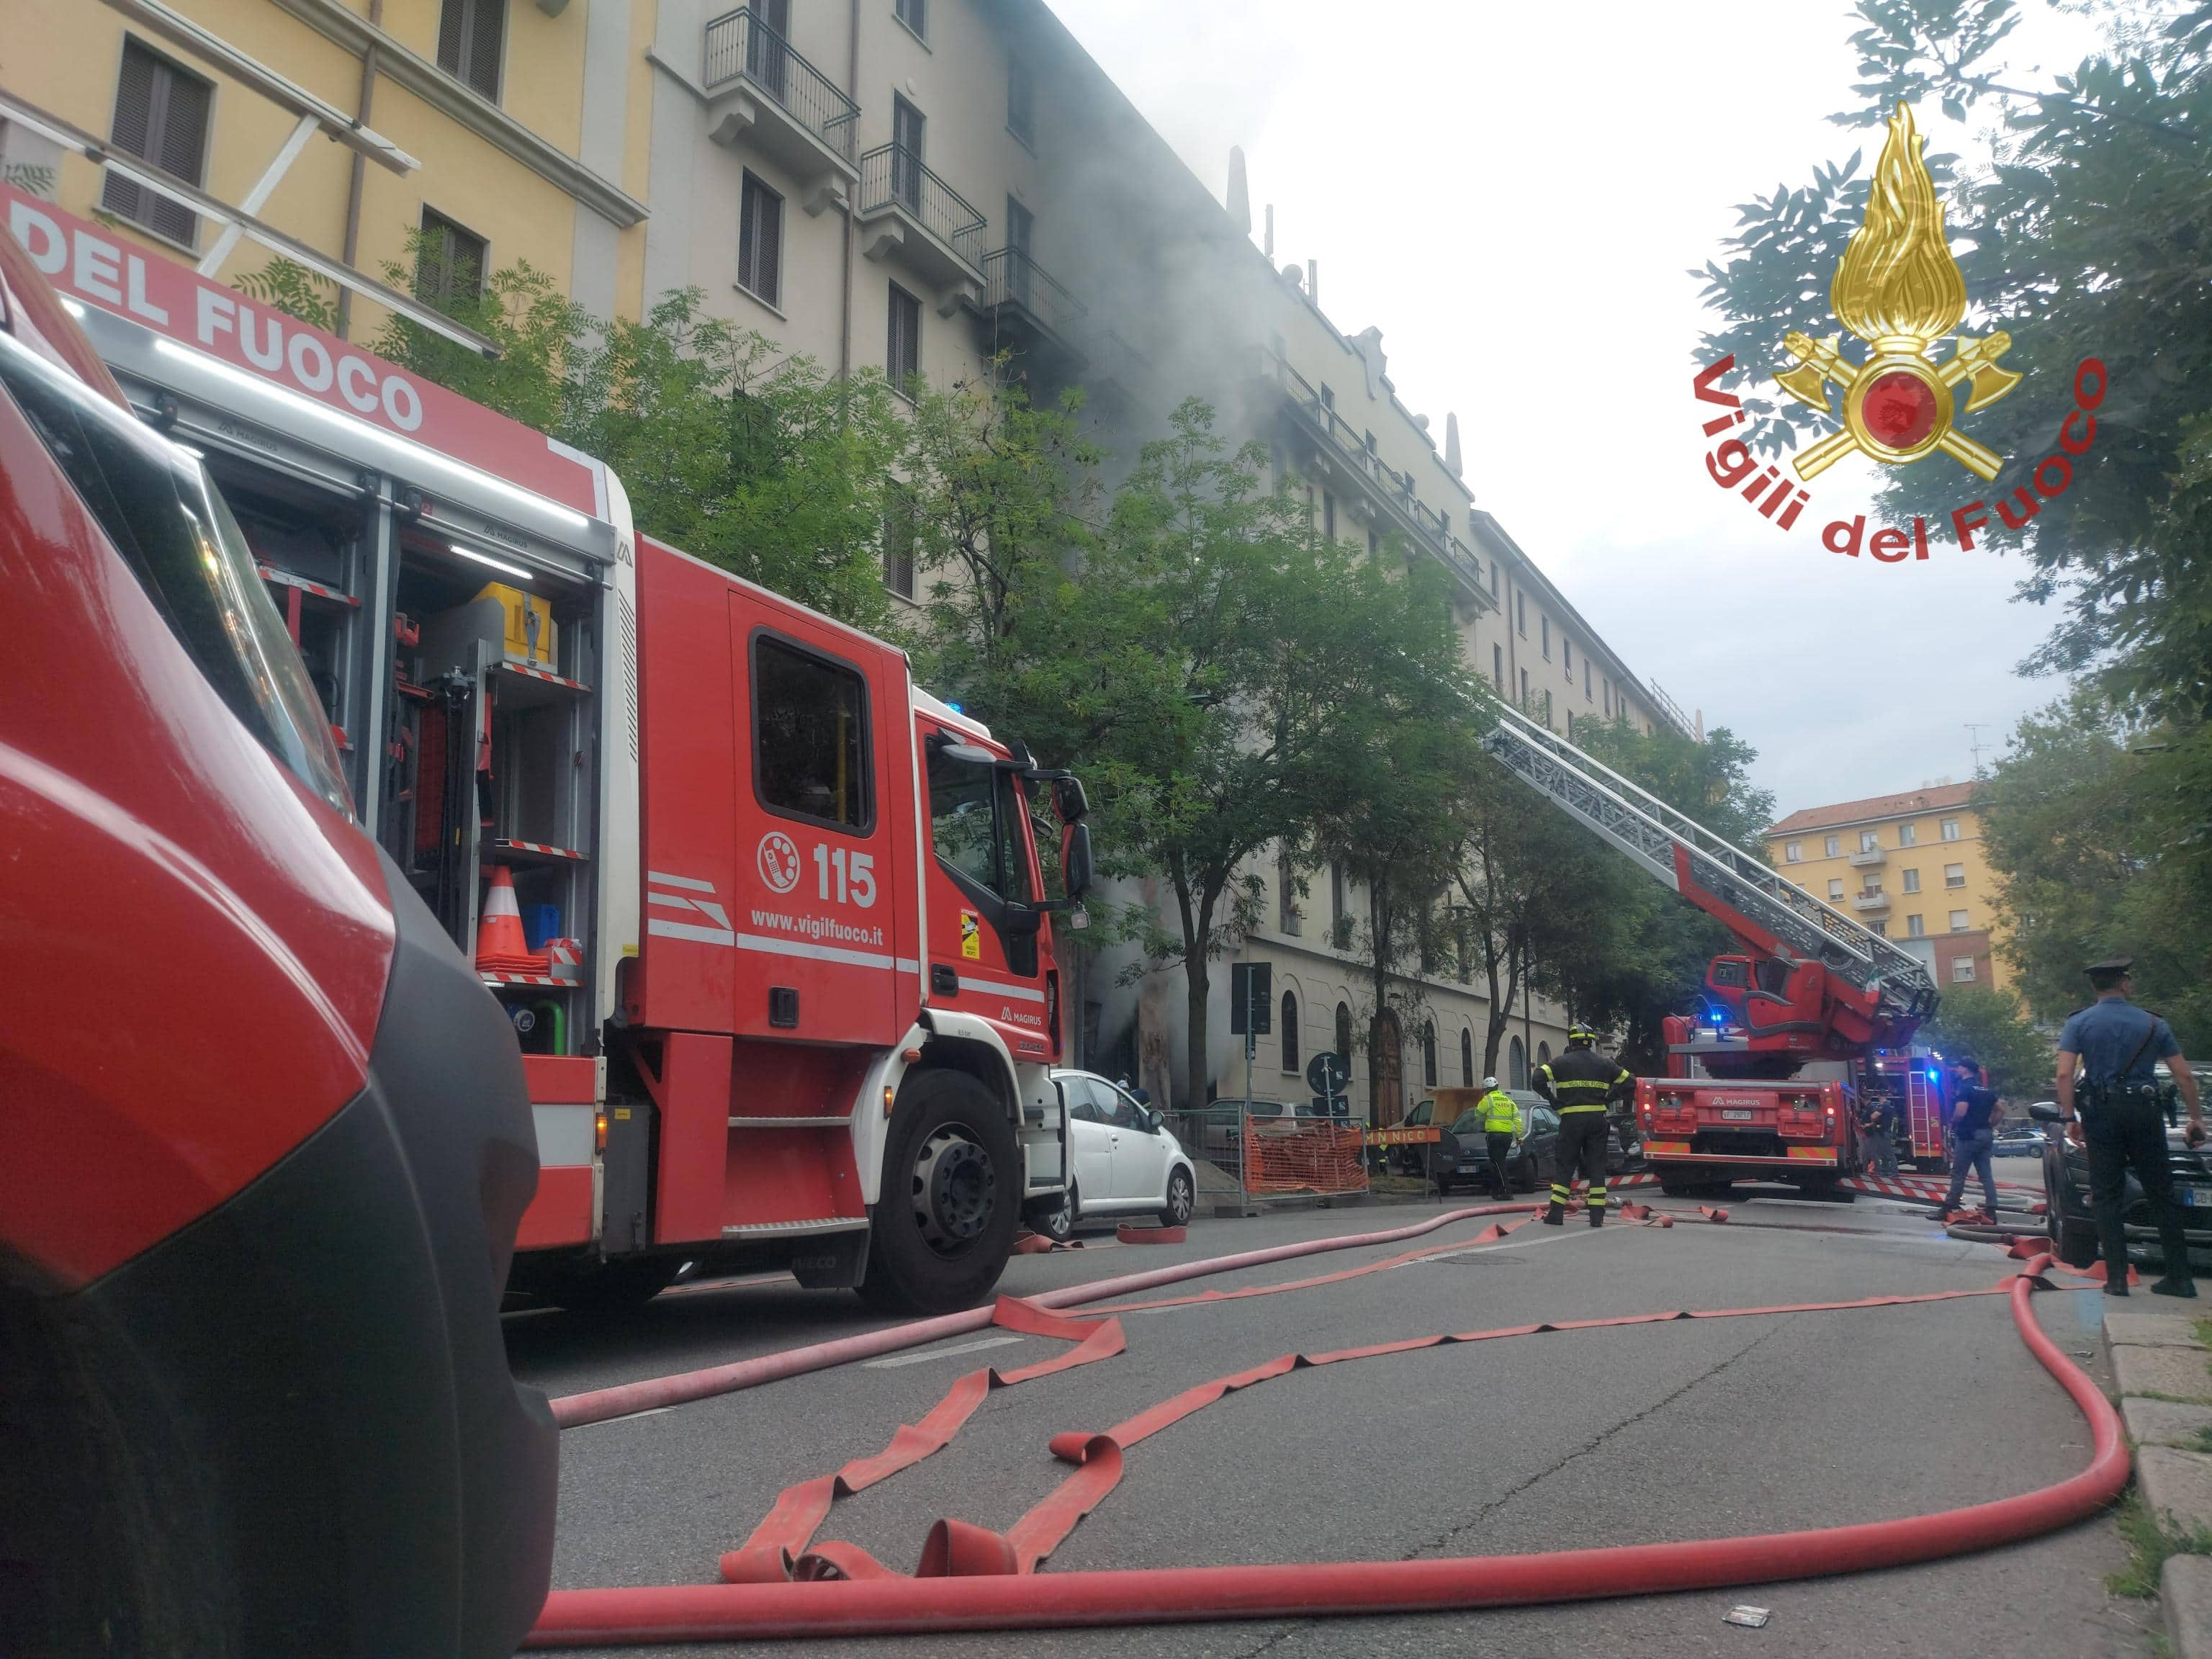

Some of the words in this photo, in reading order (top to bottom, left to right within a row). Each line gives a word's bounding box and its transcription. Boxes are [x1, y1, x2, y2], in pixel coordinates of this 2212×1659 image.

[10, 200, 169, 328] DEL
[196, 284, 423, 432] FUOCO
[497, 531, 529, 549] MAGIRUS
[813, 842, 877, 909] 115
[751, 909, 884, 945] www.vigilfuoco.it
[1013, 1013, 1041, 1025] MAGIRUS
